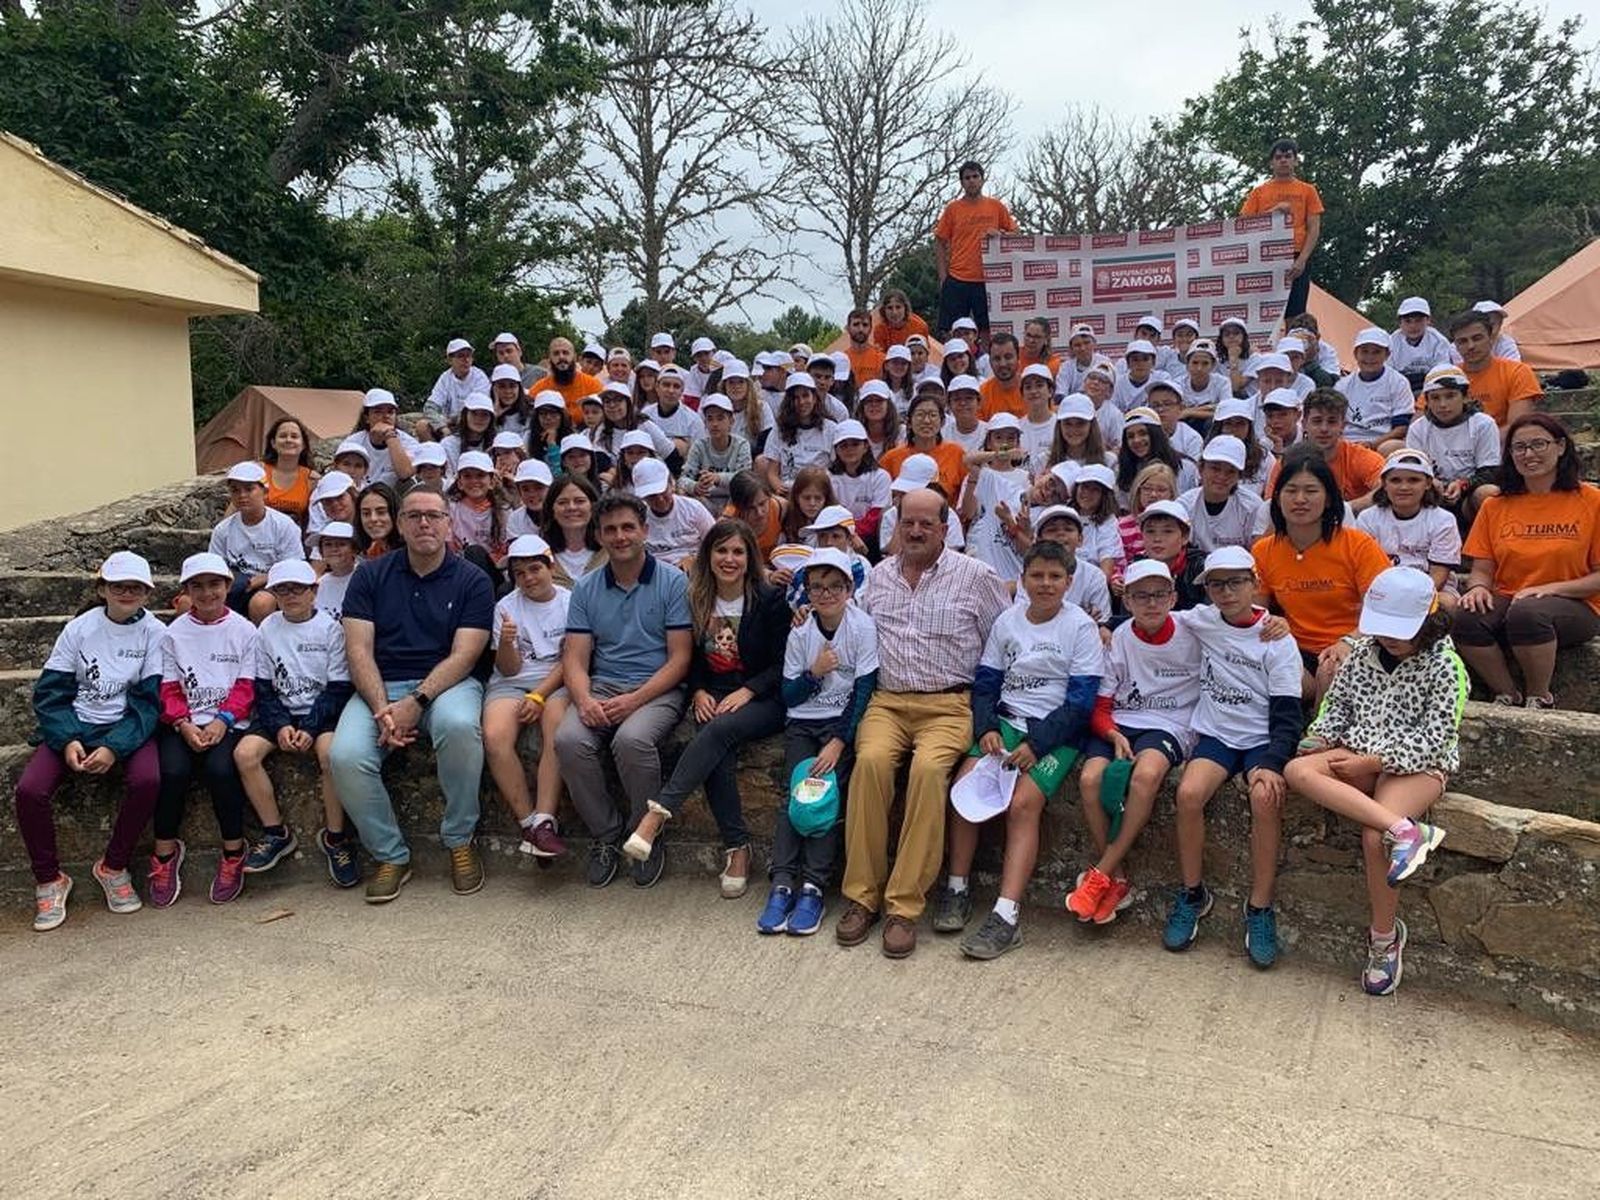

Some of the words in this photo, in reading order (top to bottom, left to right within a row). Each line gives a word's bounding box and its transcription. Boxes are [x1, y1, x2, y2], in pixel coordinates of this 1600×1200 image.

[1111, 266, 1158, 277] DIPUTACIÓN
[1160, 266, 1172, 274] DE
[1111, 274, 1173, 289] ZAMORA
[1525, 523, 1578, 535] TURMA
